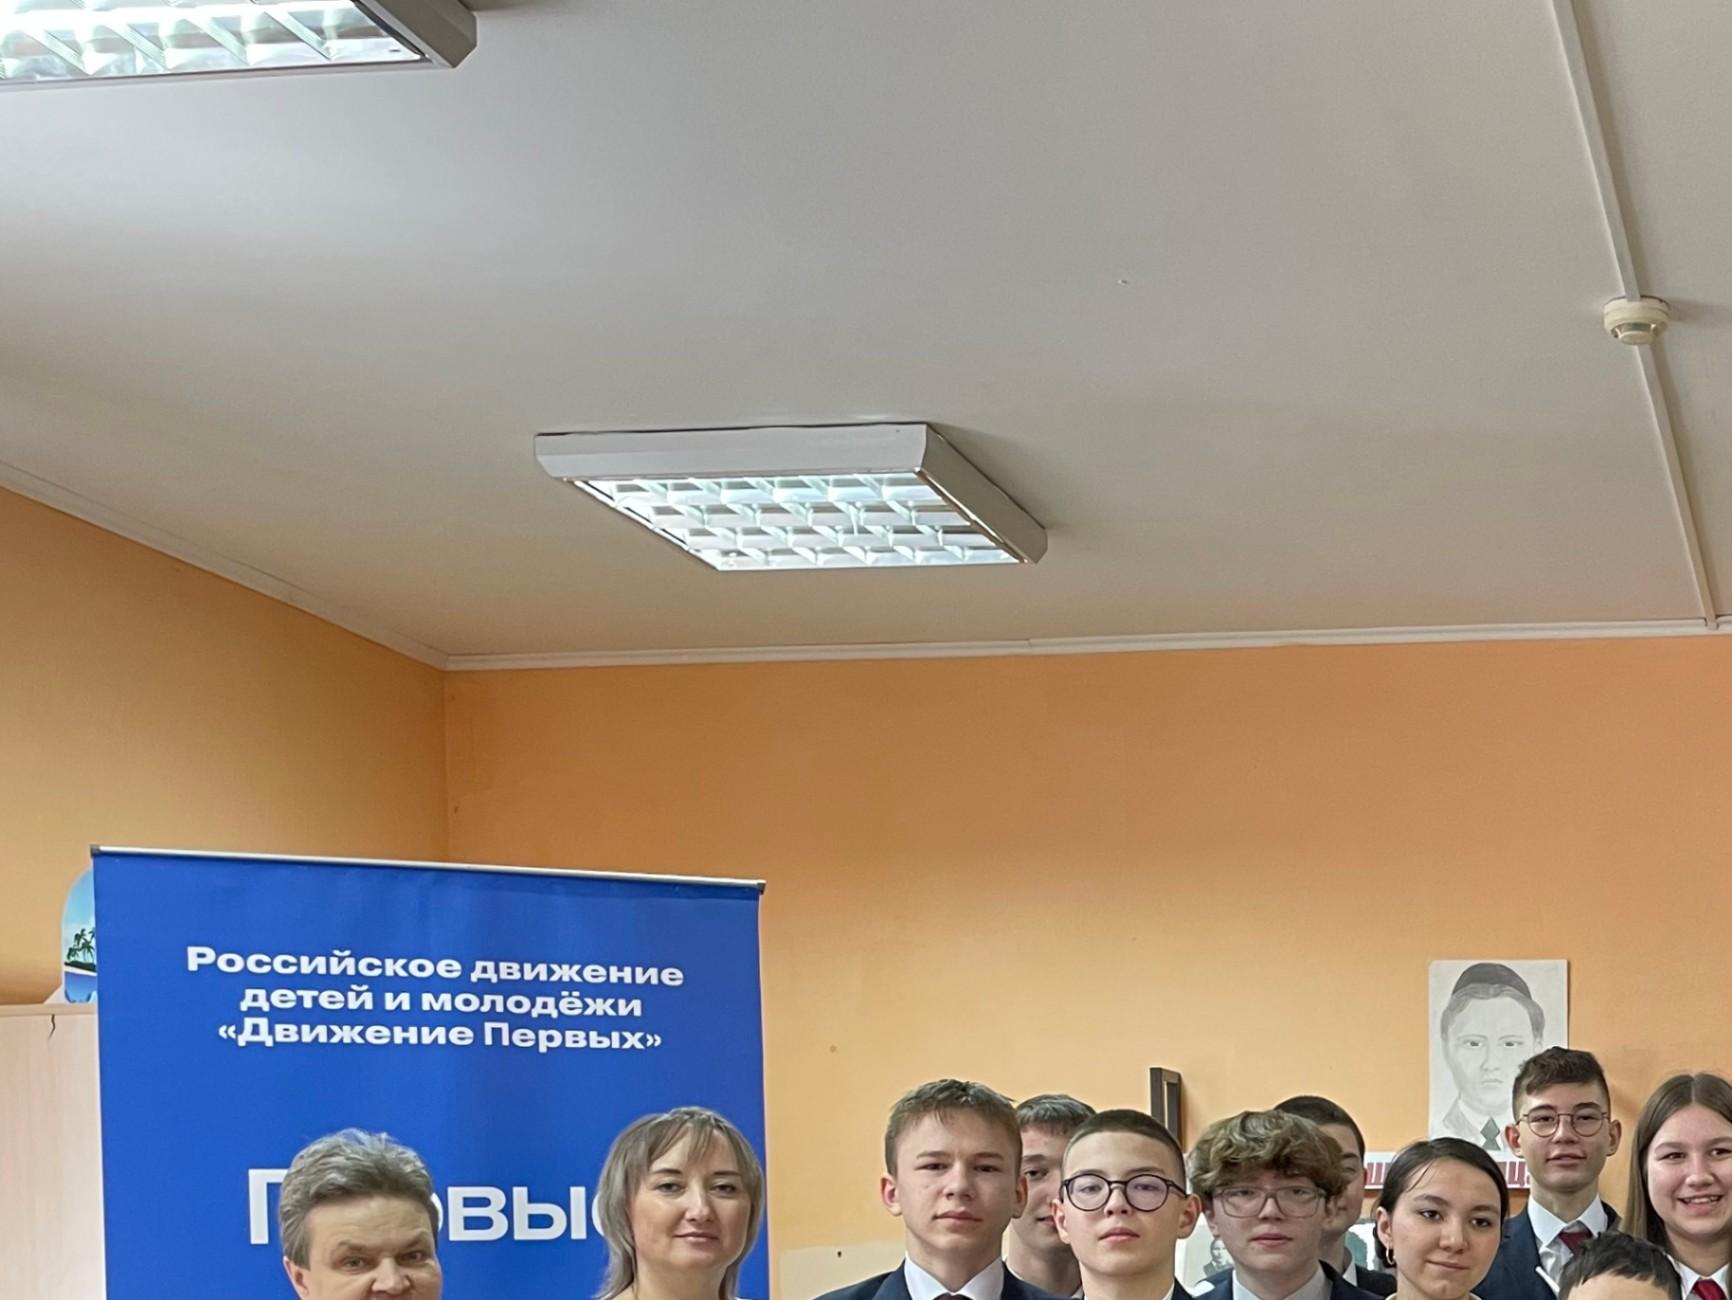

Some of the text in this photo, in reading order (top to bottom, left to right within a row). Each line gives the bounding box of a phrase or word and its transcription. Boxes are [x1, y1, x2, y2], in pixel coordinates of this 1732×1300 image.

[187, 946, 684, 986] Российское движение
[239, 984, 642, 1019] детей и молодёжи
[218, 1016, 662, 1053] «Движение Первых»
